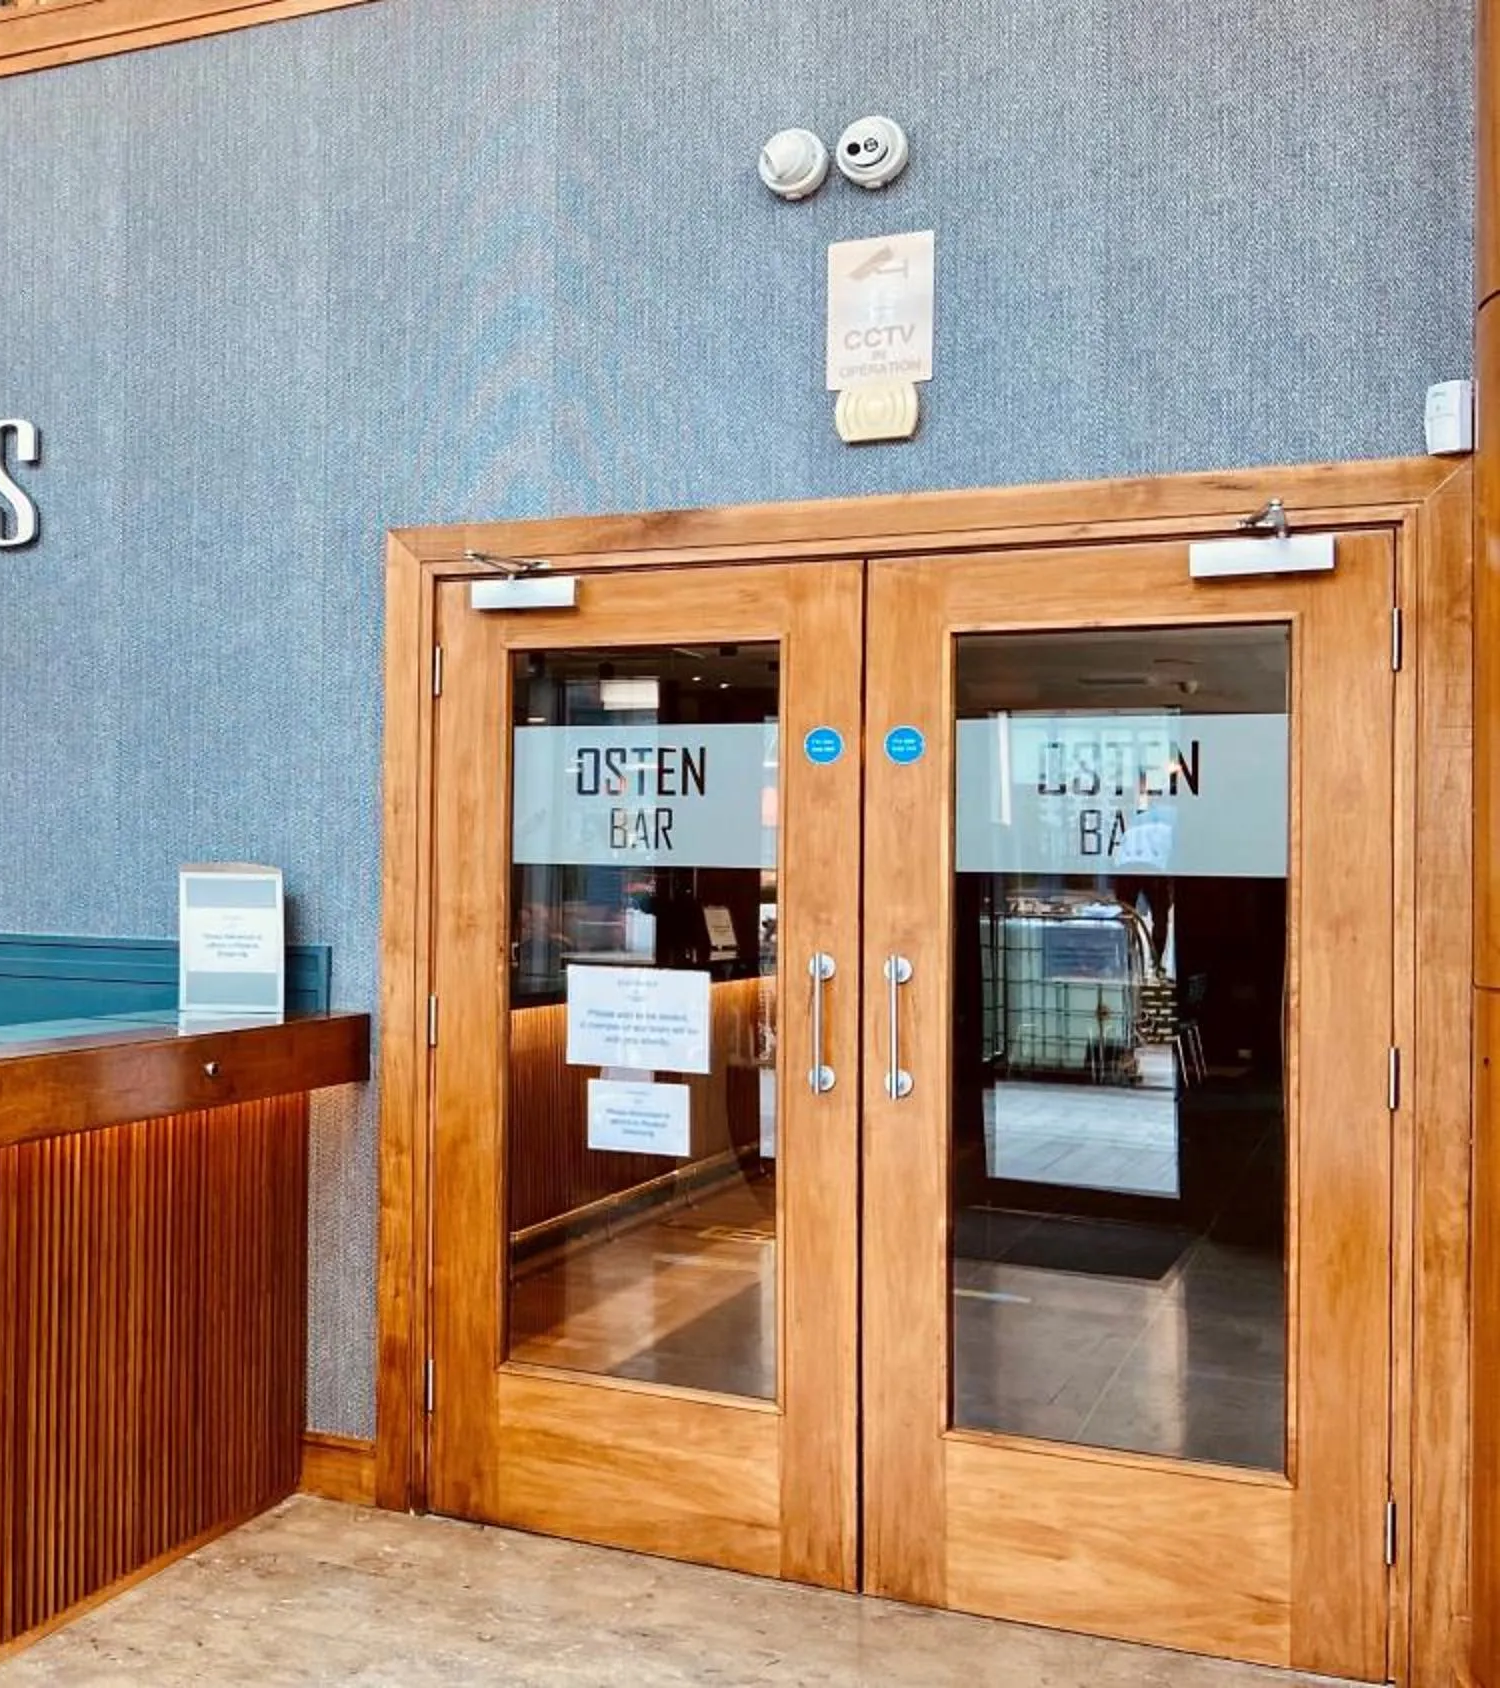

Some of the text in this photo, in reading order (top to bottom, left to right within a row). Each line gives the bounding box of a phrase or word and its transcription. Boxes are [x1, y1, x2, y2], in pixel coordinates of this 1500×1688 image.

[844, 323, 916, 350] CCTV
[576, 746, 707, 797] OSTEN
[1037, 739, 1200, 797] OSTEN
[609, 806, 674, 851] BAR
[1079, 808, 1152, 857] BA
